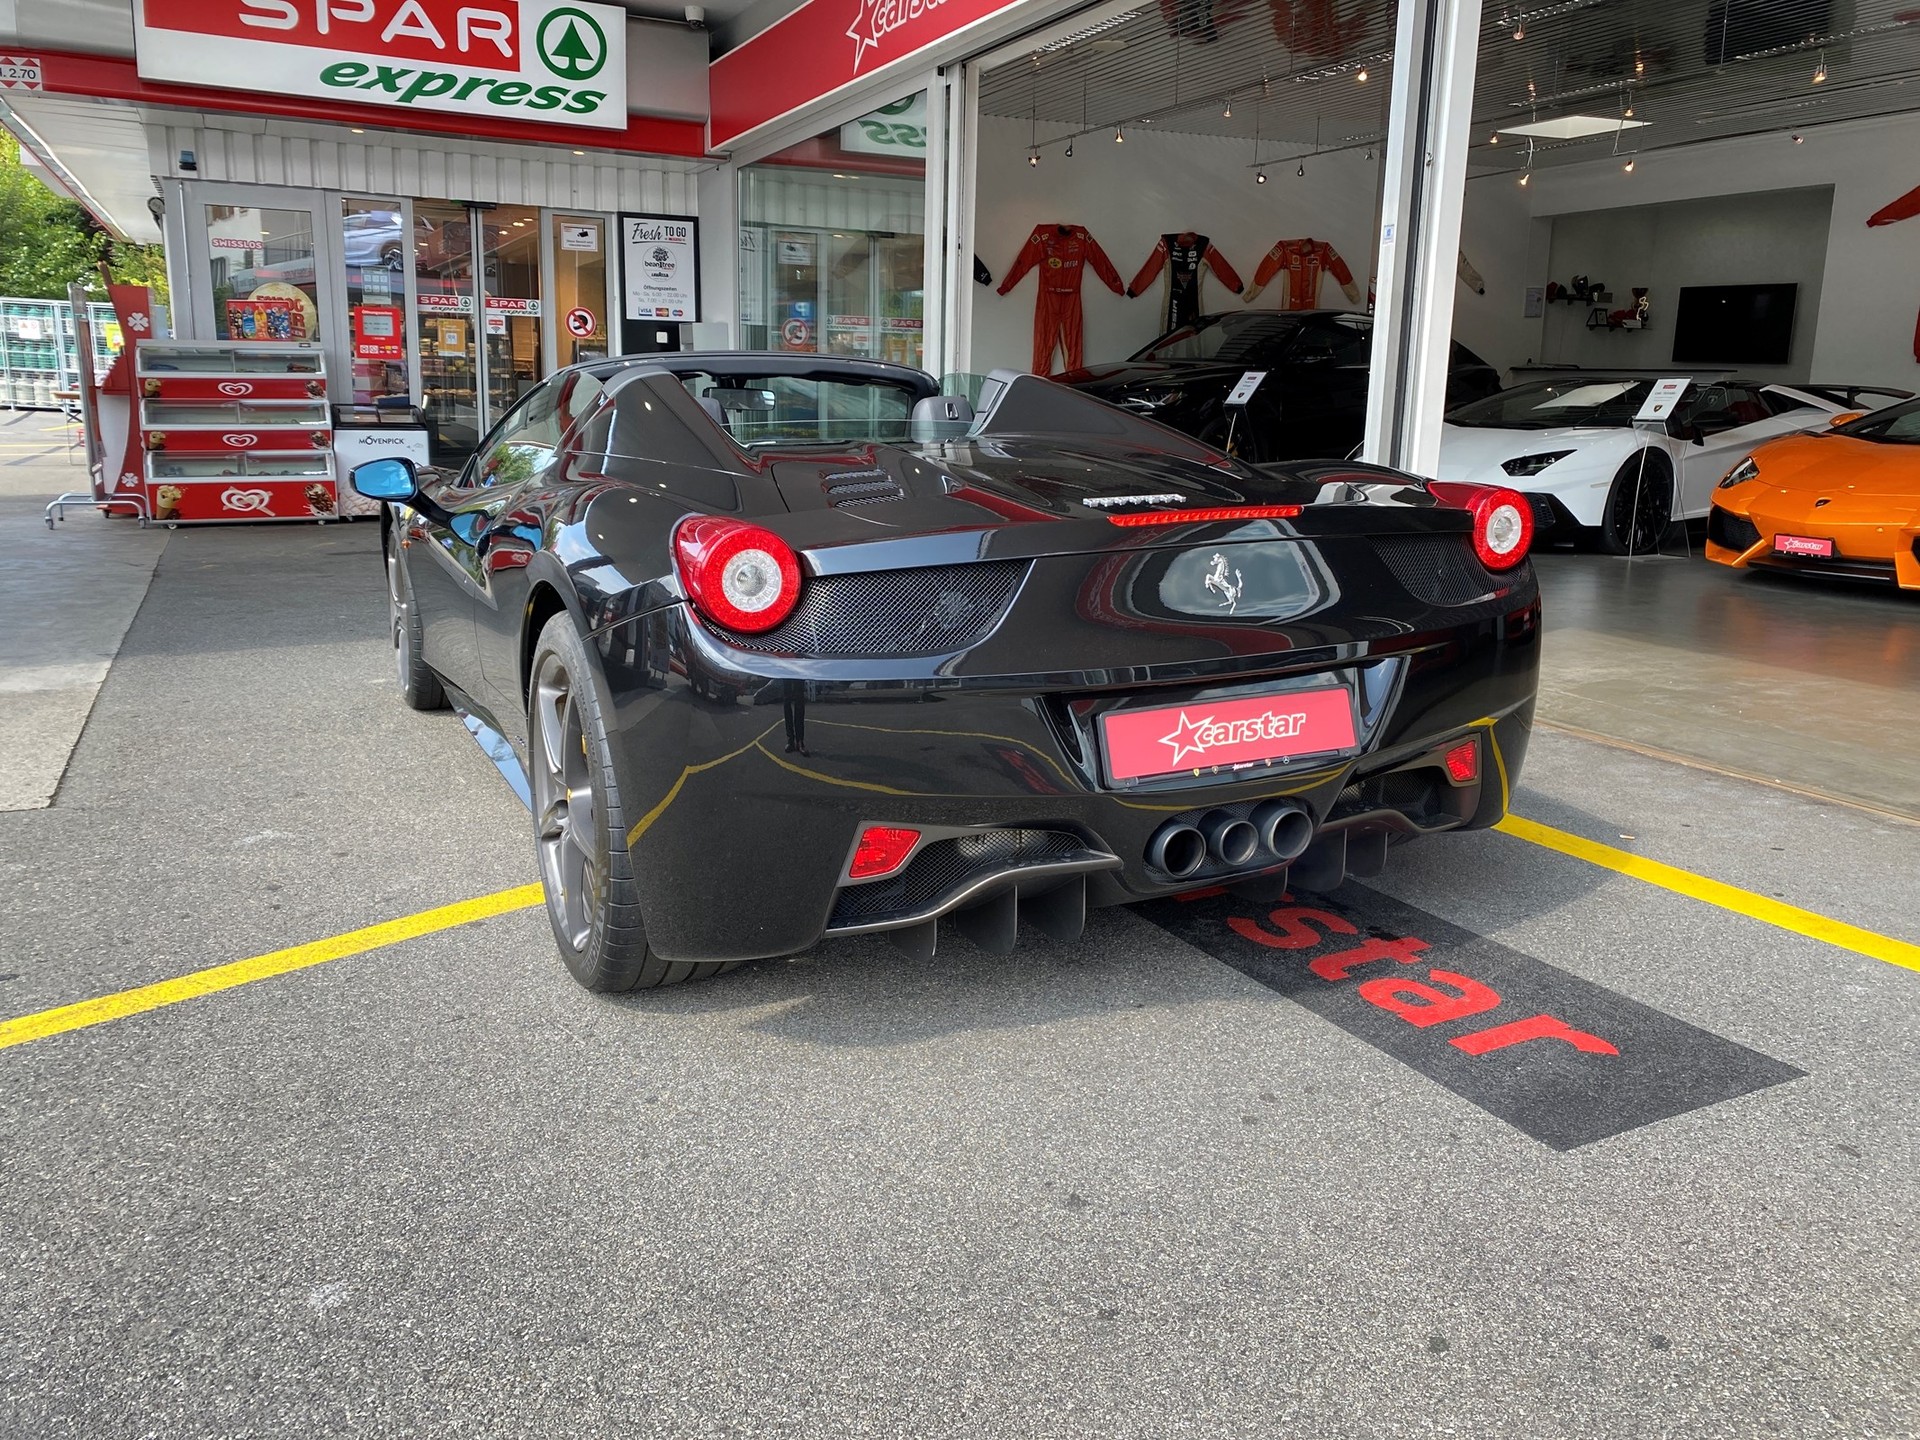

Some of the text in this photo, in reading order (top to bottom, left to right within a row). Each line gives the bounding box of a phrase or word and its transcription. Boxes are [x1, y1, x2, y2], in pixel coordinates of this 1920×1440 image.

[238, 0, 513, 58] SPAR
[9, 68, 36, 79] 2.70
[319, 61, 608, 114] express
[631, 222, 686, 240] Fresh TO GO
[212, 238, 263, 249] SWISSLOS
[421, 296, 459, 305] SPAR
[490, 300, 526, 308] SPAR
[1197, 711, 1307, 749] carstar
